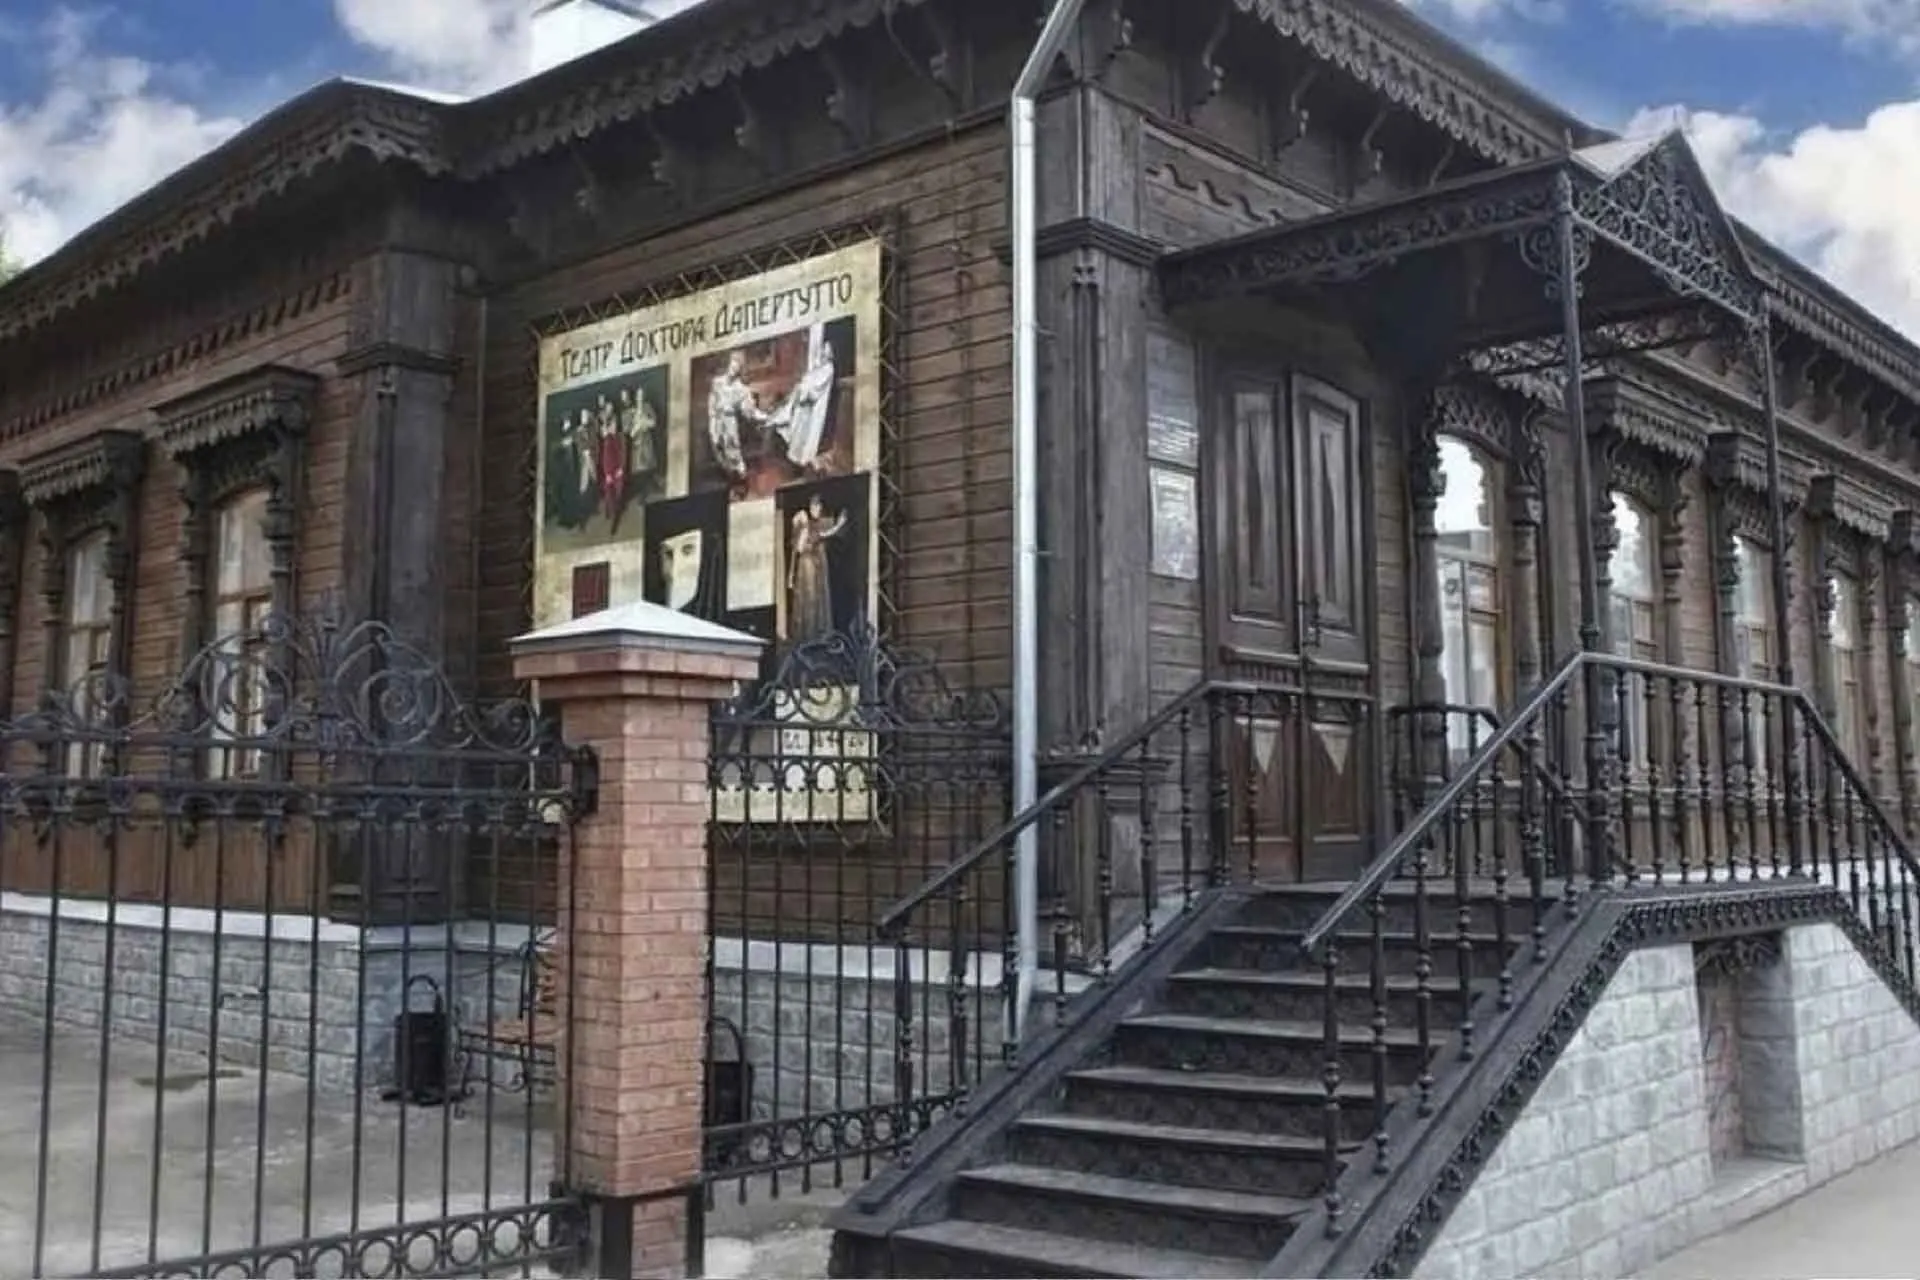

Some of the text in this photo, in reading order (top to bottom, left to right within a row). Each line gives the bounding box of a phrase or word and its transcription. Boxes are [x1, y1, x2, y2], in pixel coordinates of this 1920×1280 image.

[560, 273, 852, 380] ТЕАТР ДОКТОРА ДАПЕРТУТТО
